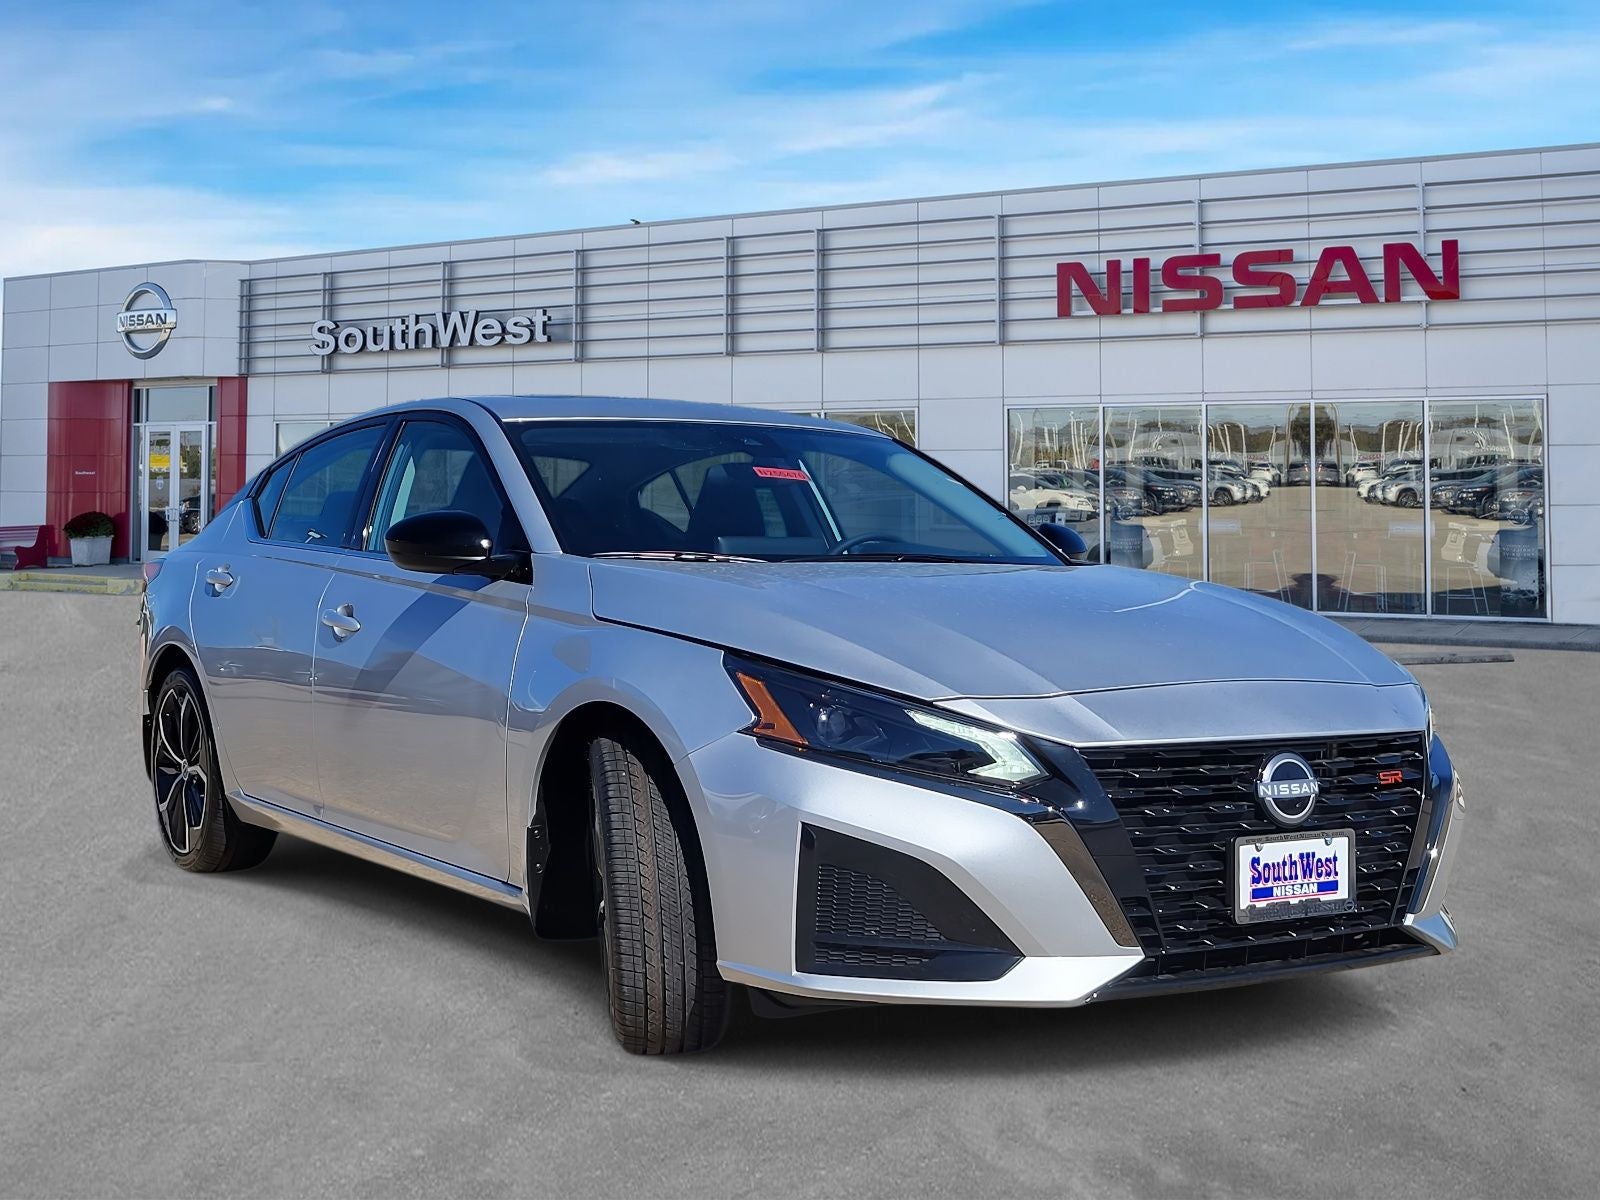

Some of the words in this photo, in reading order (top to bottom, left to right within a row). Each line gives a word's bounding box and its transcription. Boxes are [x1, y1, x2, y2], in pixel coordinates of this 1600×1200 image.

[1056, 239, 1461, 318] NISSAN
[118, 313, 167, 328] NISSAN
[309, 308, 551, 356] SouthWest
[1379, 770, 1403, 785] SR
[1259, 783, 1319, 797] NISSAN
[1249, 849, 1339, 887] SouthWest
[1272, 882, 1319, 898] NISSAN
